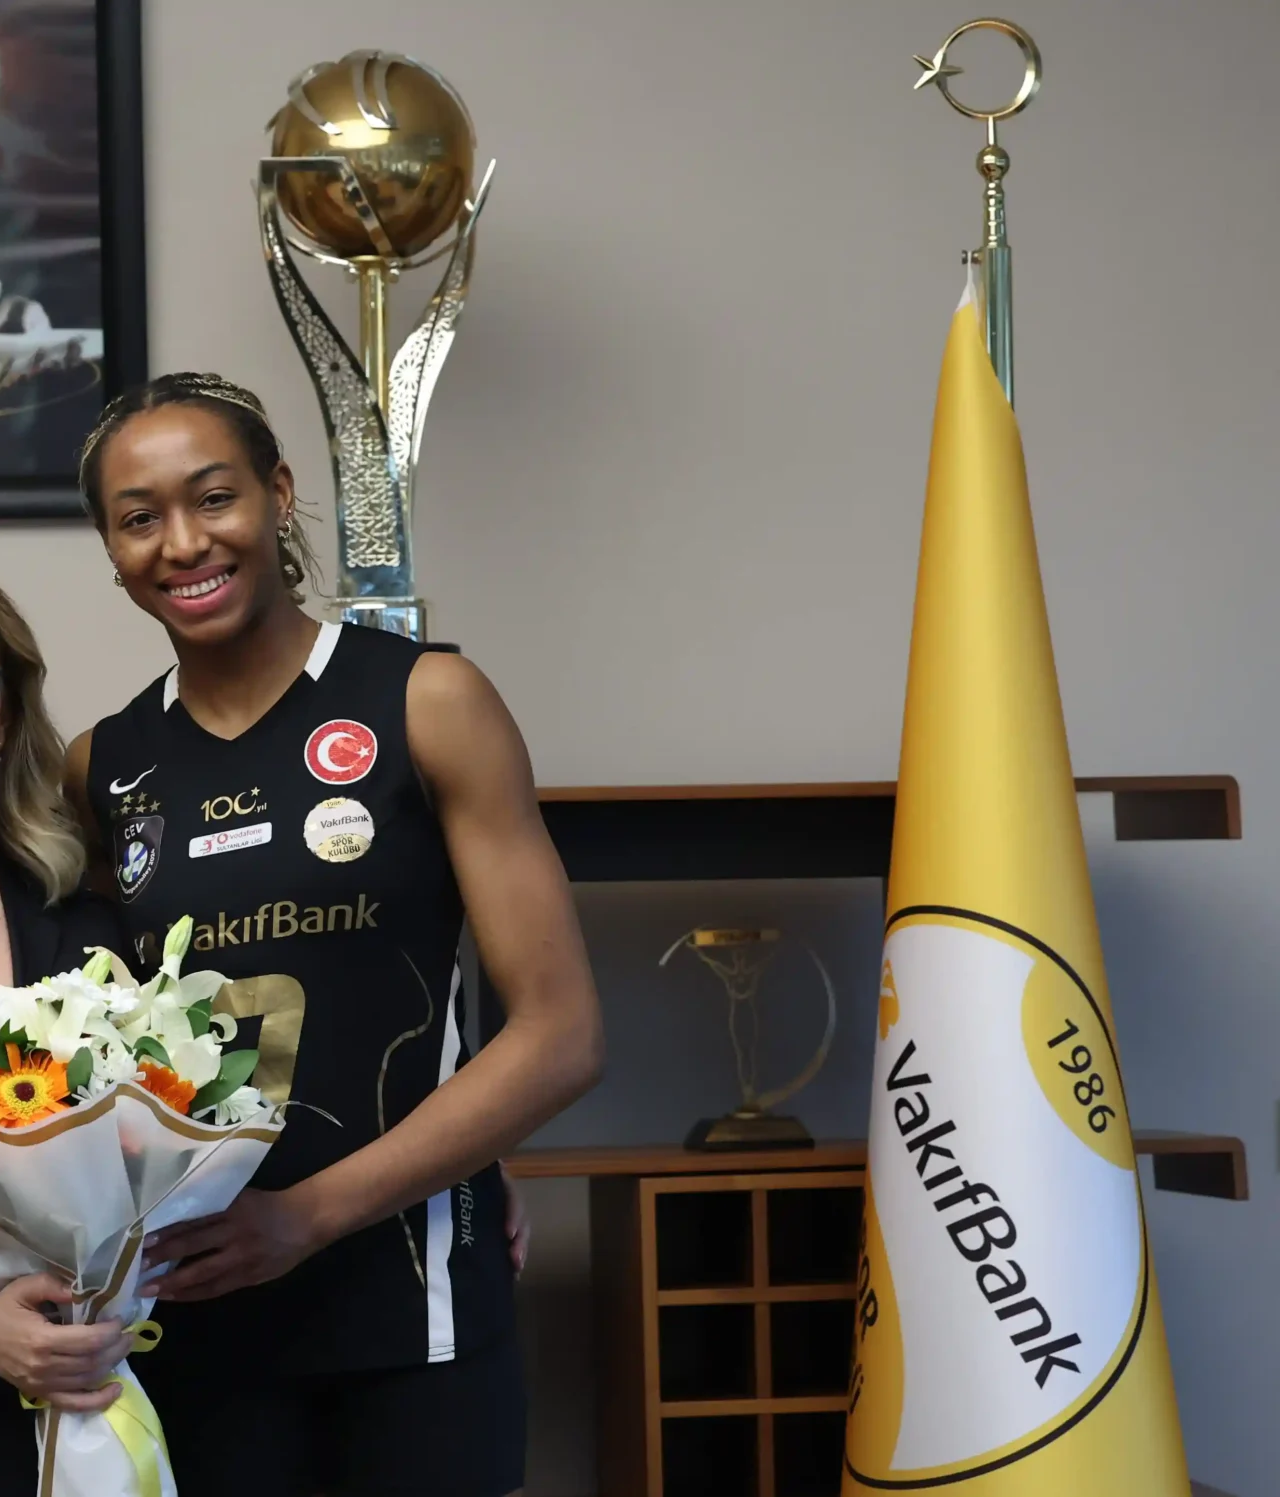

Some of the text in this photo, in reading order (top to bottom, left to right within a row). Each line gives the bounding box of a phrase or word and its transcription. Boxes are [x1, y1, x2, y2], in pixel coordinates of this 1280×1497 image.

[320, 814, 370, 829] VakıfBank
[124, 822, 145, 840] CEV
[229, 828, 262, 840] vodafone
[216, 841, 249, 852] SULTANLAR
[328, 844, 361, 857] KULÜBÜ
[331, 837, 354, 848] SPOR
[167, 894, 381, 951] akıfBank
[1046, 1017, 1116, 1134] 1986
[460, 1181, 475, 1247] ıfBank
[886, 1039, 1081, 1389] VakıfBank
